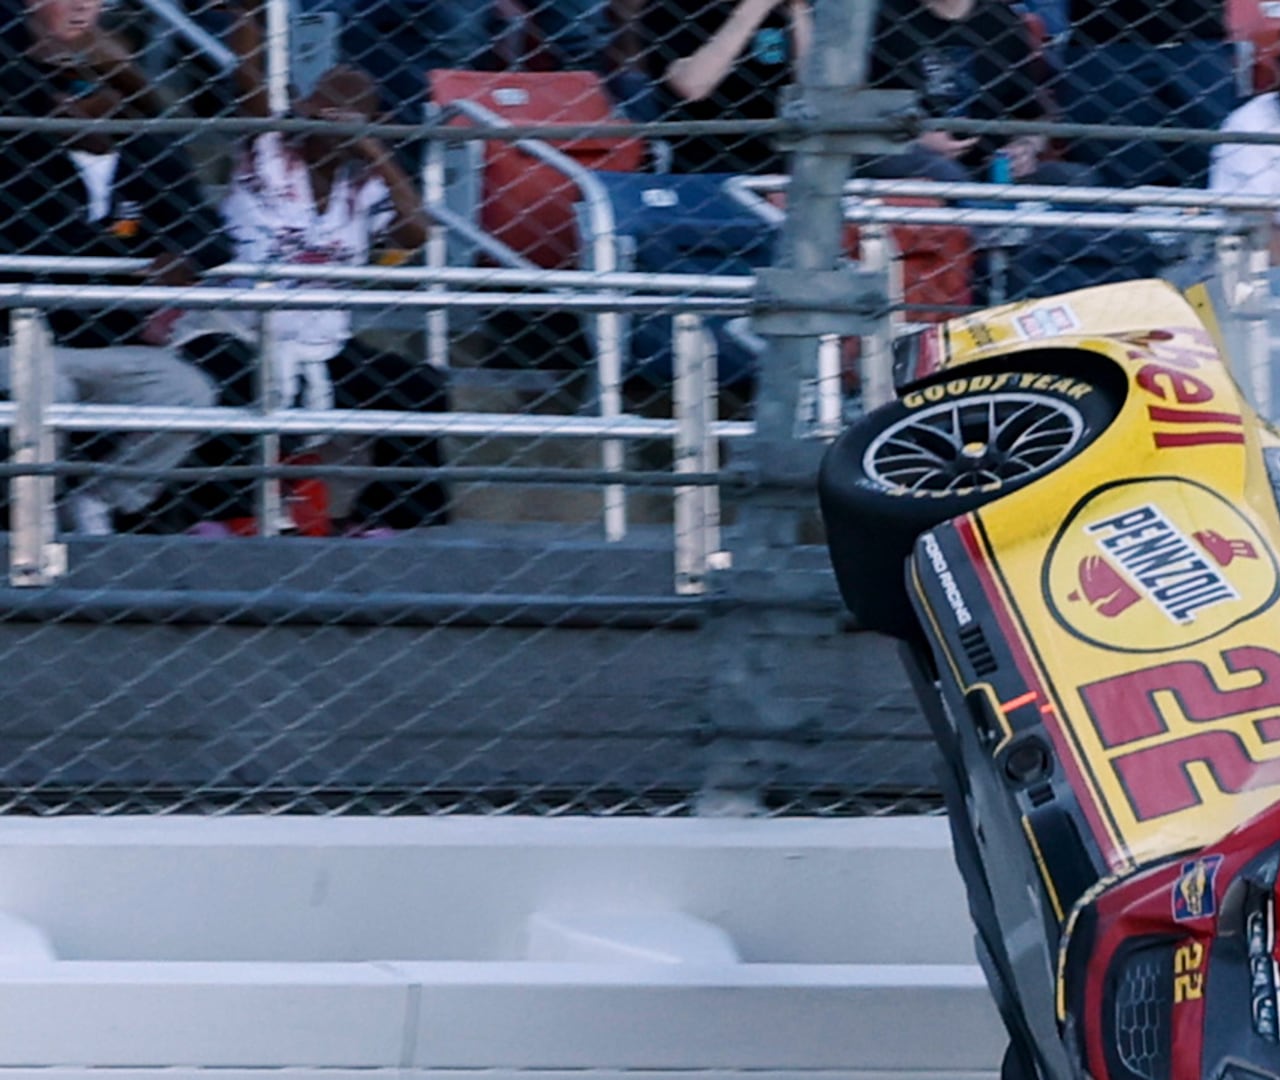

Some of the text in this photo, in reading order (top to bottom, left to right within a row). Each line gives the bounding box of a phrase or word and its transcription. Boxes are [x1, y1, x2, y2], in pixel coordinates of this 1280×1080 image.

[922, 533, 973, 627] FORD RACING
[1089, 505, 1237, 622] PENNZOIL
[1174, 942, 1204, 1004] 22
